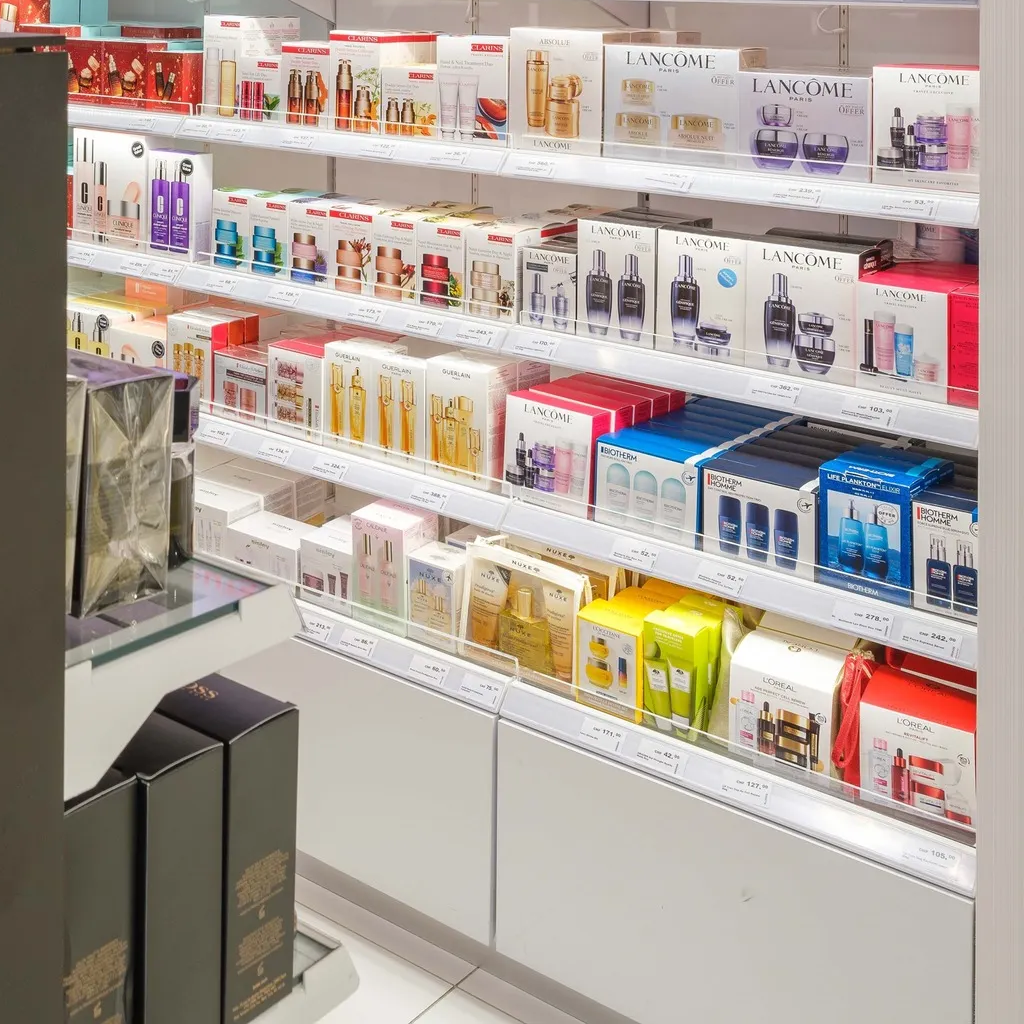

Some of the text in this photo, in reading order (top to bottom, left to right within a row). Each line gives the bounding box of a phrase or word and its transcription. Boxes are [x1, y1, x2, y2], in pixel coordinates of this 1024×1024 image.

[348, 35, 378, 43] CLARINS
[472, 44, 503, 52] CLARINS
[626, 50, 716, 70] LANCÔME
[409, 72, 433, 80] CLARINS
[711, 76, 735, 86] OFFER
[899, 72, 970, 86] LANCÔME
[752, 77, 853, 99] LANCÔME
[838, 105, 865, 116] OFFER
[533, 140, 572, 151] LANCÔME
[339, 213, 369, 222] CLARINS
[437, 228, 461, 237] CLARINS
[591, 225, 641, 240] LANCÔME
[489, 235, 513, 244] CLARINS
[675, 235, 730, 252] LANCÔME
[529, 252, 570, 264] LANCÔME
[762, 248, 842, 271] LANCÔME
[875, 287, 926, 303] LANCÔME
[335, 351, 361, 363] GUERLAIN
[381, 364, 412, 375] GUERLAIN
[442, 368, 471, 379] GUERLAIN
[524, 403, 573, 425] LANCÔME
[604, 447, 638, 462] BIOTHERM
[710, 480, 736, 492] HOMME
[711, 473, 742, 487] BIOTHERM
[827, 473, 841, 482] LIFE
[881, 484, 900, 494] ELIXIR
[921, 507, 958, 521] BIOTHERM
[921, 514, 951, 527] HOMME
[546, 547, 567, 558] NUXE
[511, 560, 533, 571] NUXE
[419, 571, 442, 583] NUXE
[480, 572, 500, 583] NUXE
[847, 582, 879, 596] BIOTHERM
[549, 592, 568, 602] NUXE
[865, 613, 890, 623] 278.00
[510, 626, 531, 638] NUXE
[930, 632, 956, 643] 242.00
[762, 676, 797, 693] L'ORÉAL
[896, 716, 935, 734] L'ORÉAL
[602, 728, 622, 739] 171.0
[663, 750, 681, 760] 42.0
[931, 850, 956, 861] 105.00
